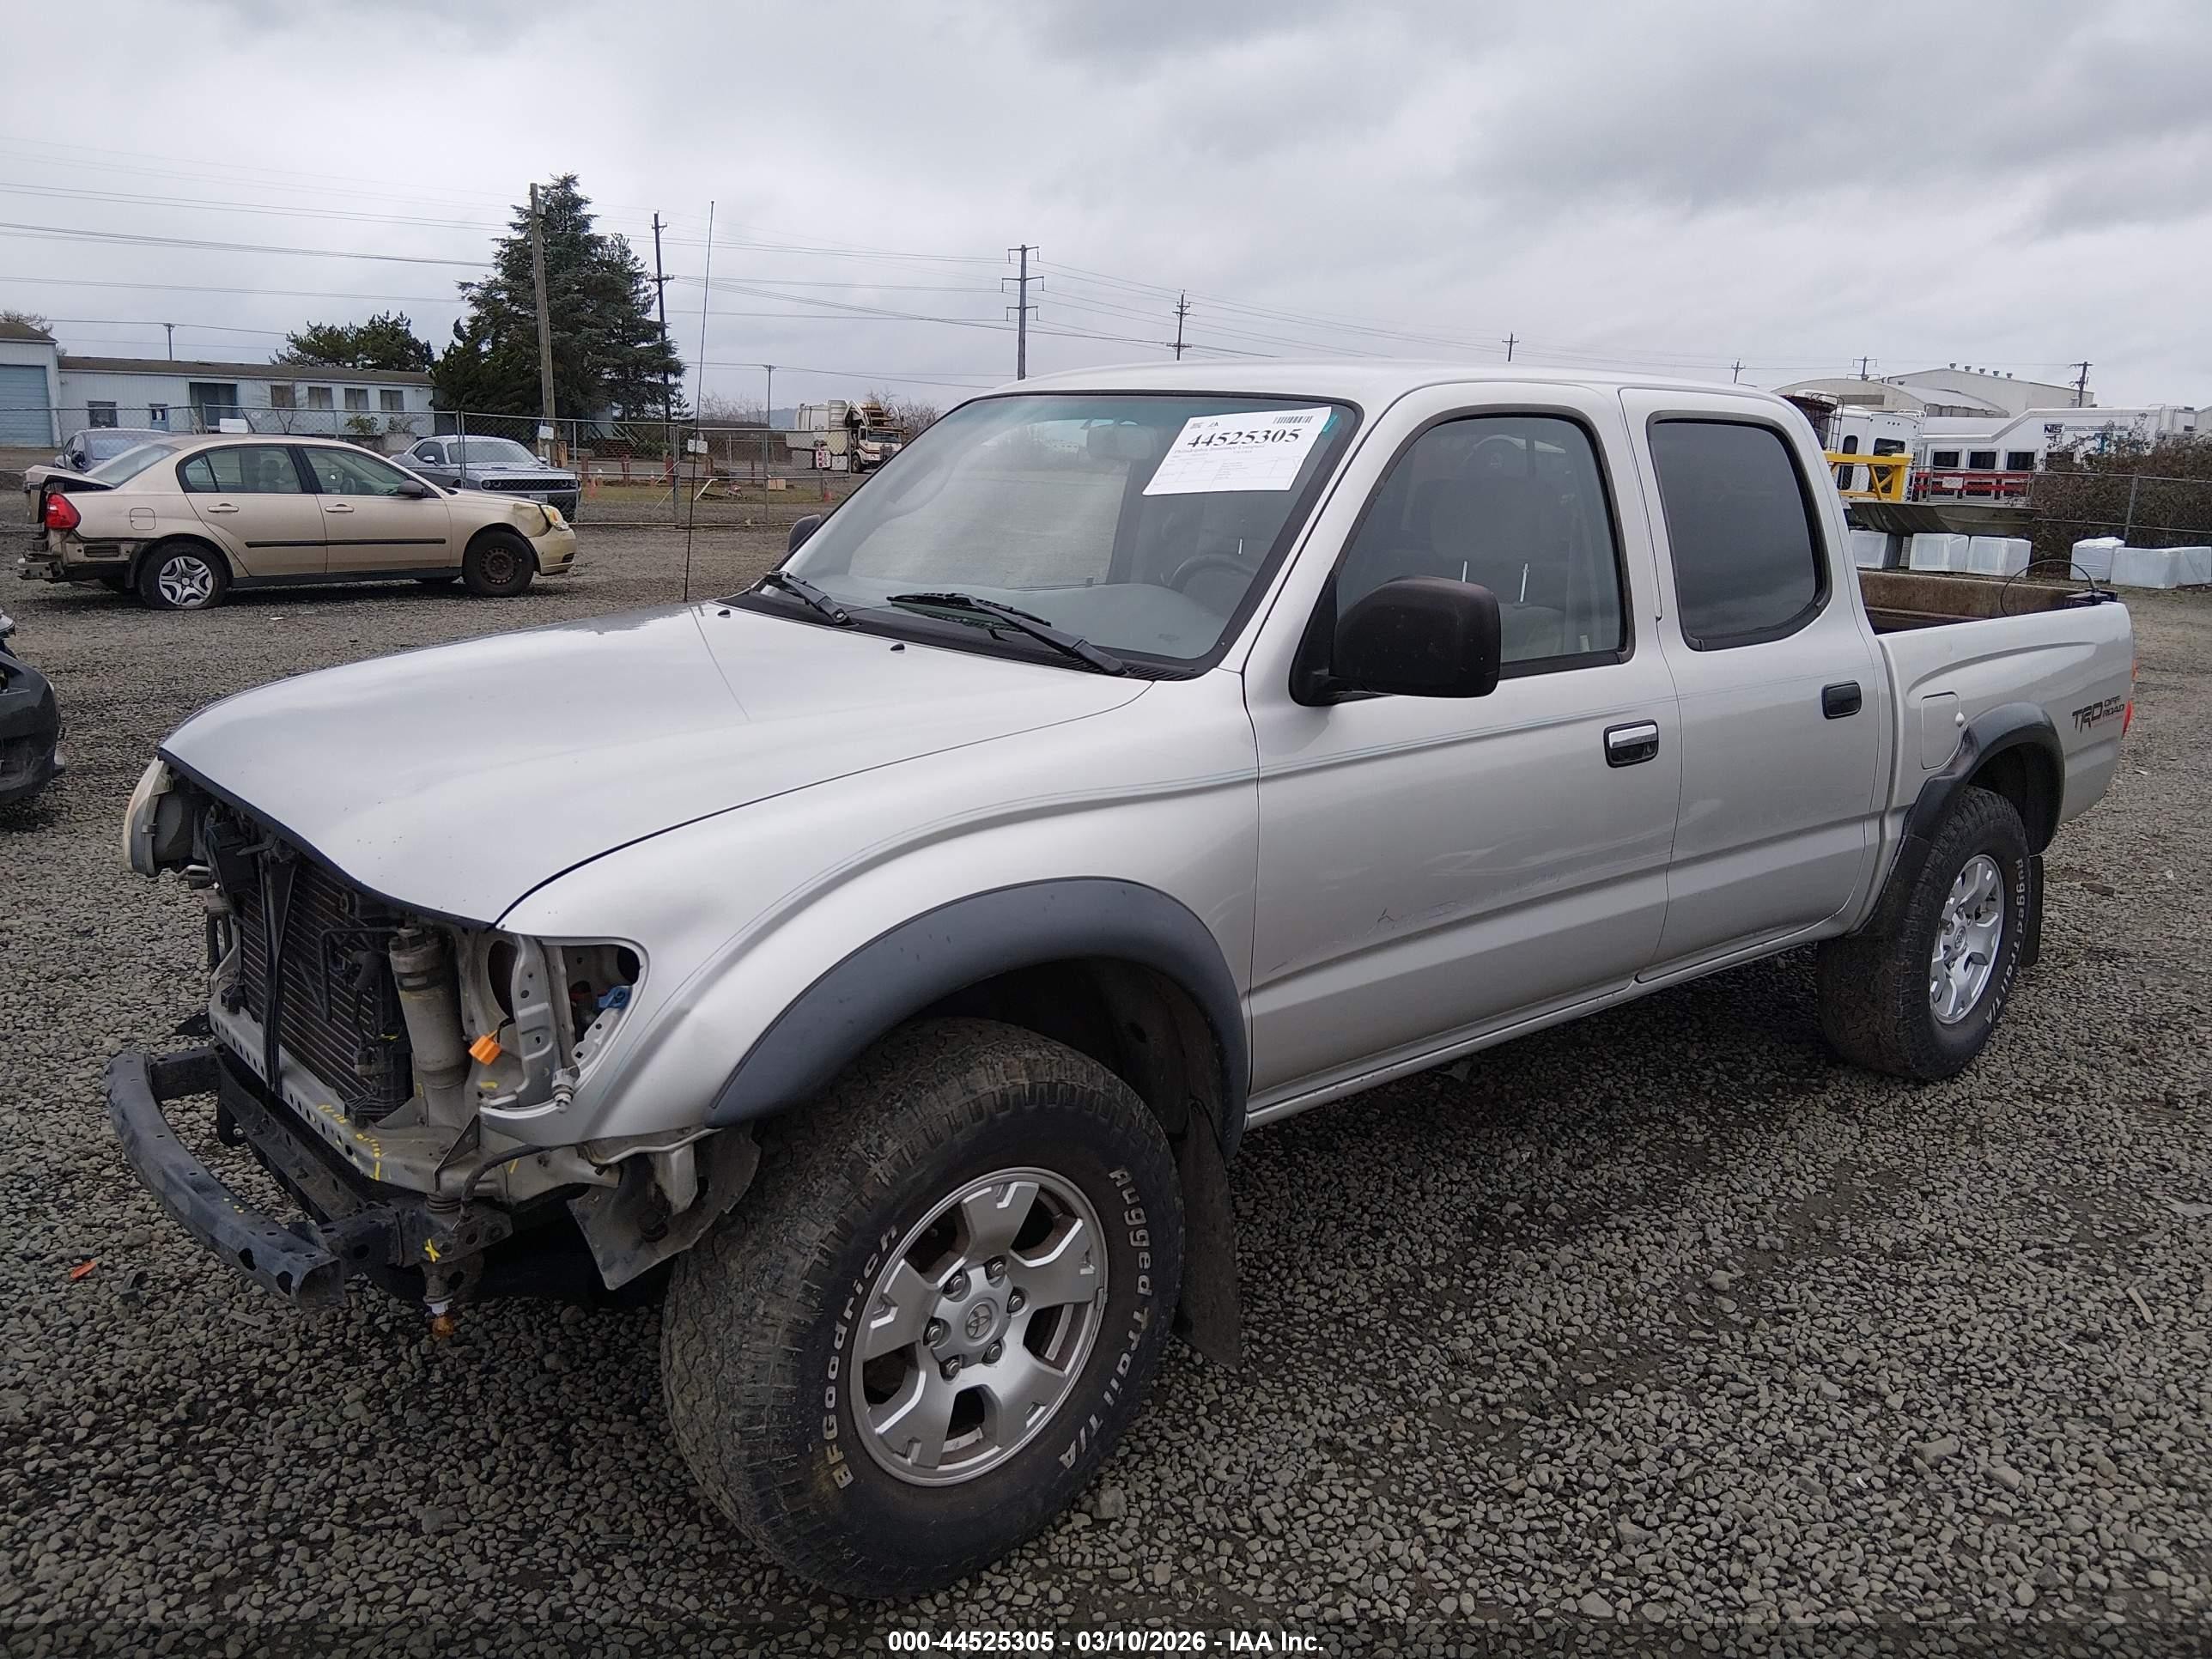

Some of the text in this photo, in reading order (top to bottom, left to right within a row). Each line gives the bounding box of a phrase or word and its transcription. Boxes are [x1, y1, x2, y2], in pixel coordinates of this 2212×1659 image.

[1188, 428, 1303, 447] 44525305
[2044, 424, 2063, 433] NTS
[2103, 704, 2125, 718] ROAD
[2104, 695, 2121, 707] OFF
[2071, 702, 2103, 733] TRD
[1109, 1168, 1153, 1297] Rugged
[822, 1224, 898, 1490] BFGoodrich
[1058, 1413, 1103, 1469] T/A
